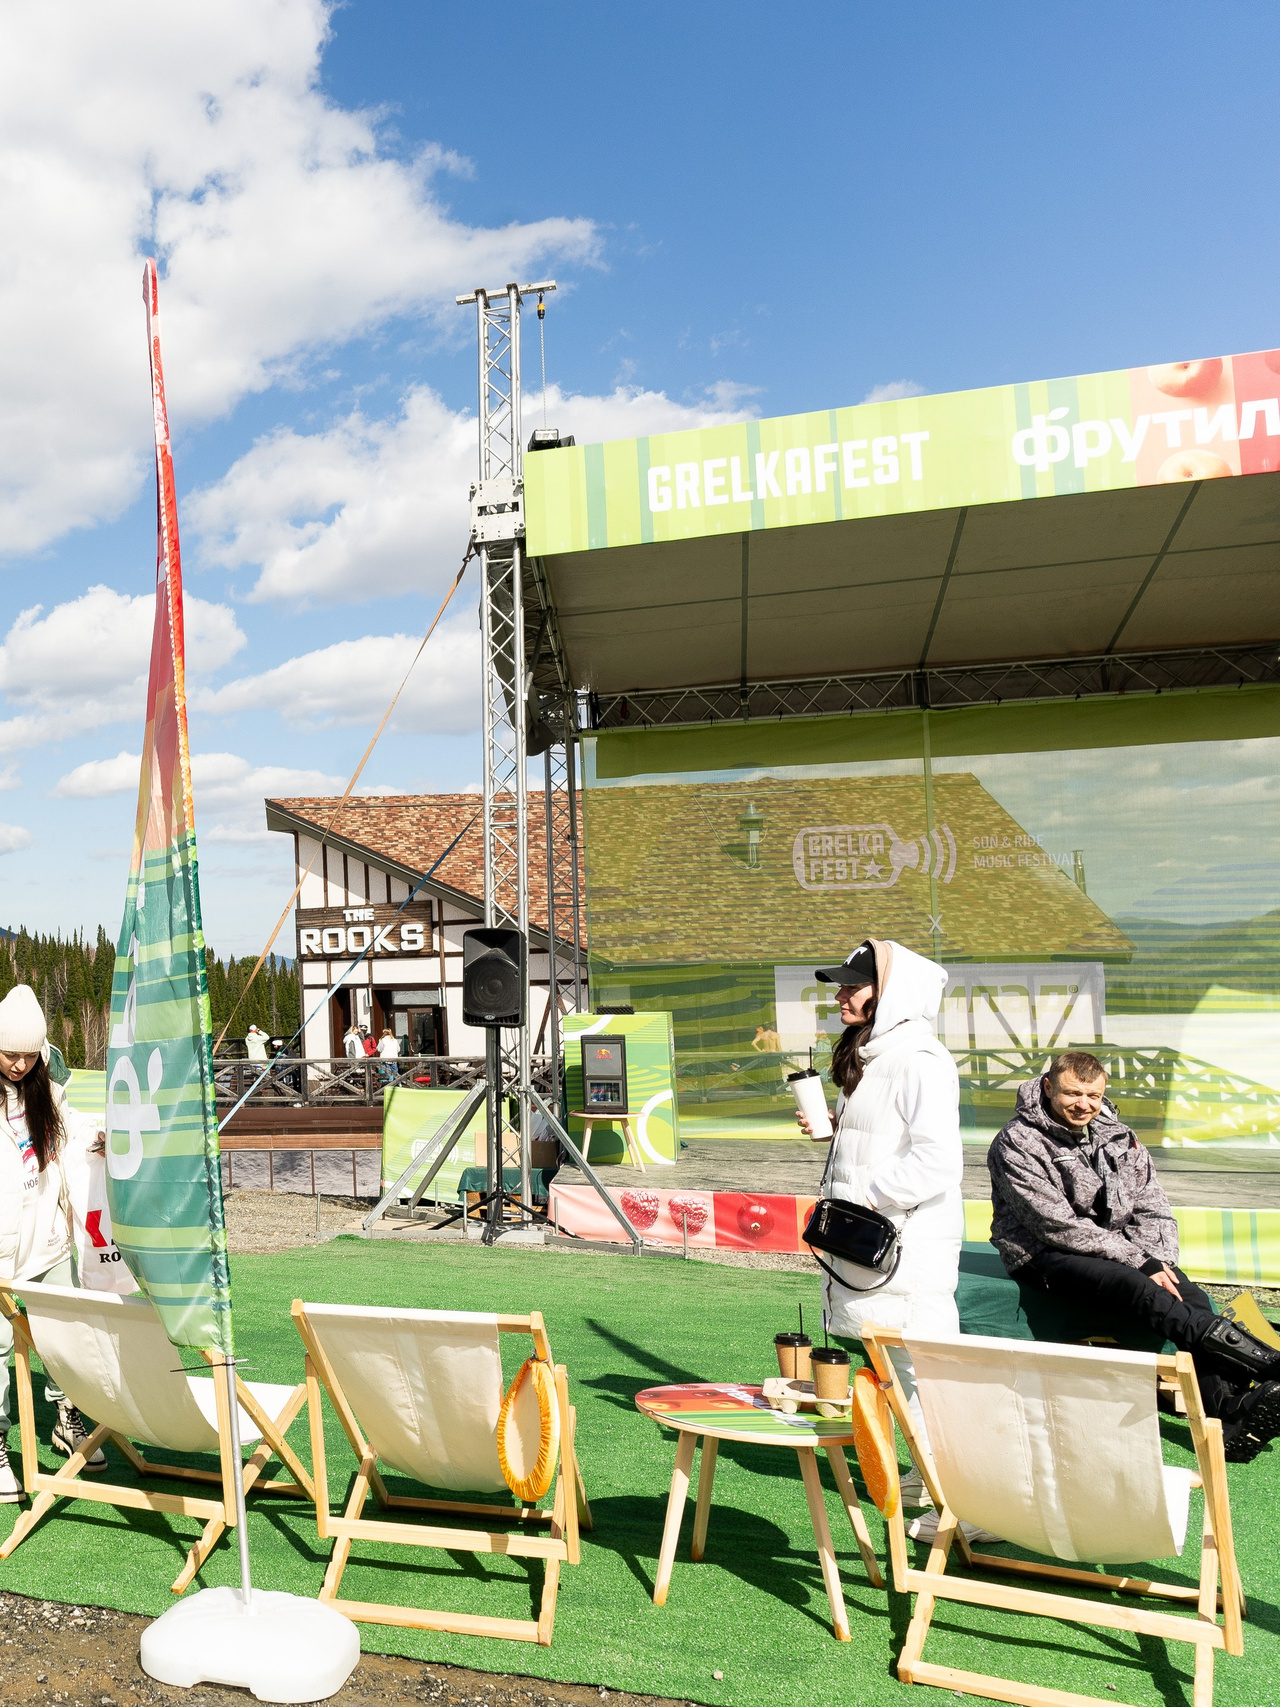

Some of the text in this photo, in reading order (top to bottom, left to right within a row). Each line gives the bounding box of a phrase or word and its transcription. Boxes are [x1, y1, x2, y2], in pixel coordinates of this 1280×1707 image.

[647, 431, 931, 514] GRELKAFEST
[808, 833, 885, 857] GRELKA
[973, 834, 1044, 849] SUN & RIDE
[809, 858, 862, 882] FEST
[974, 853, 1077, 868] MUSIC FESTIVAL
[343, 908, 375, 922] THE
[300, 923, 425, 955] ROOKS
